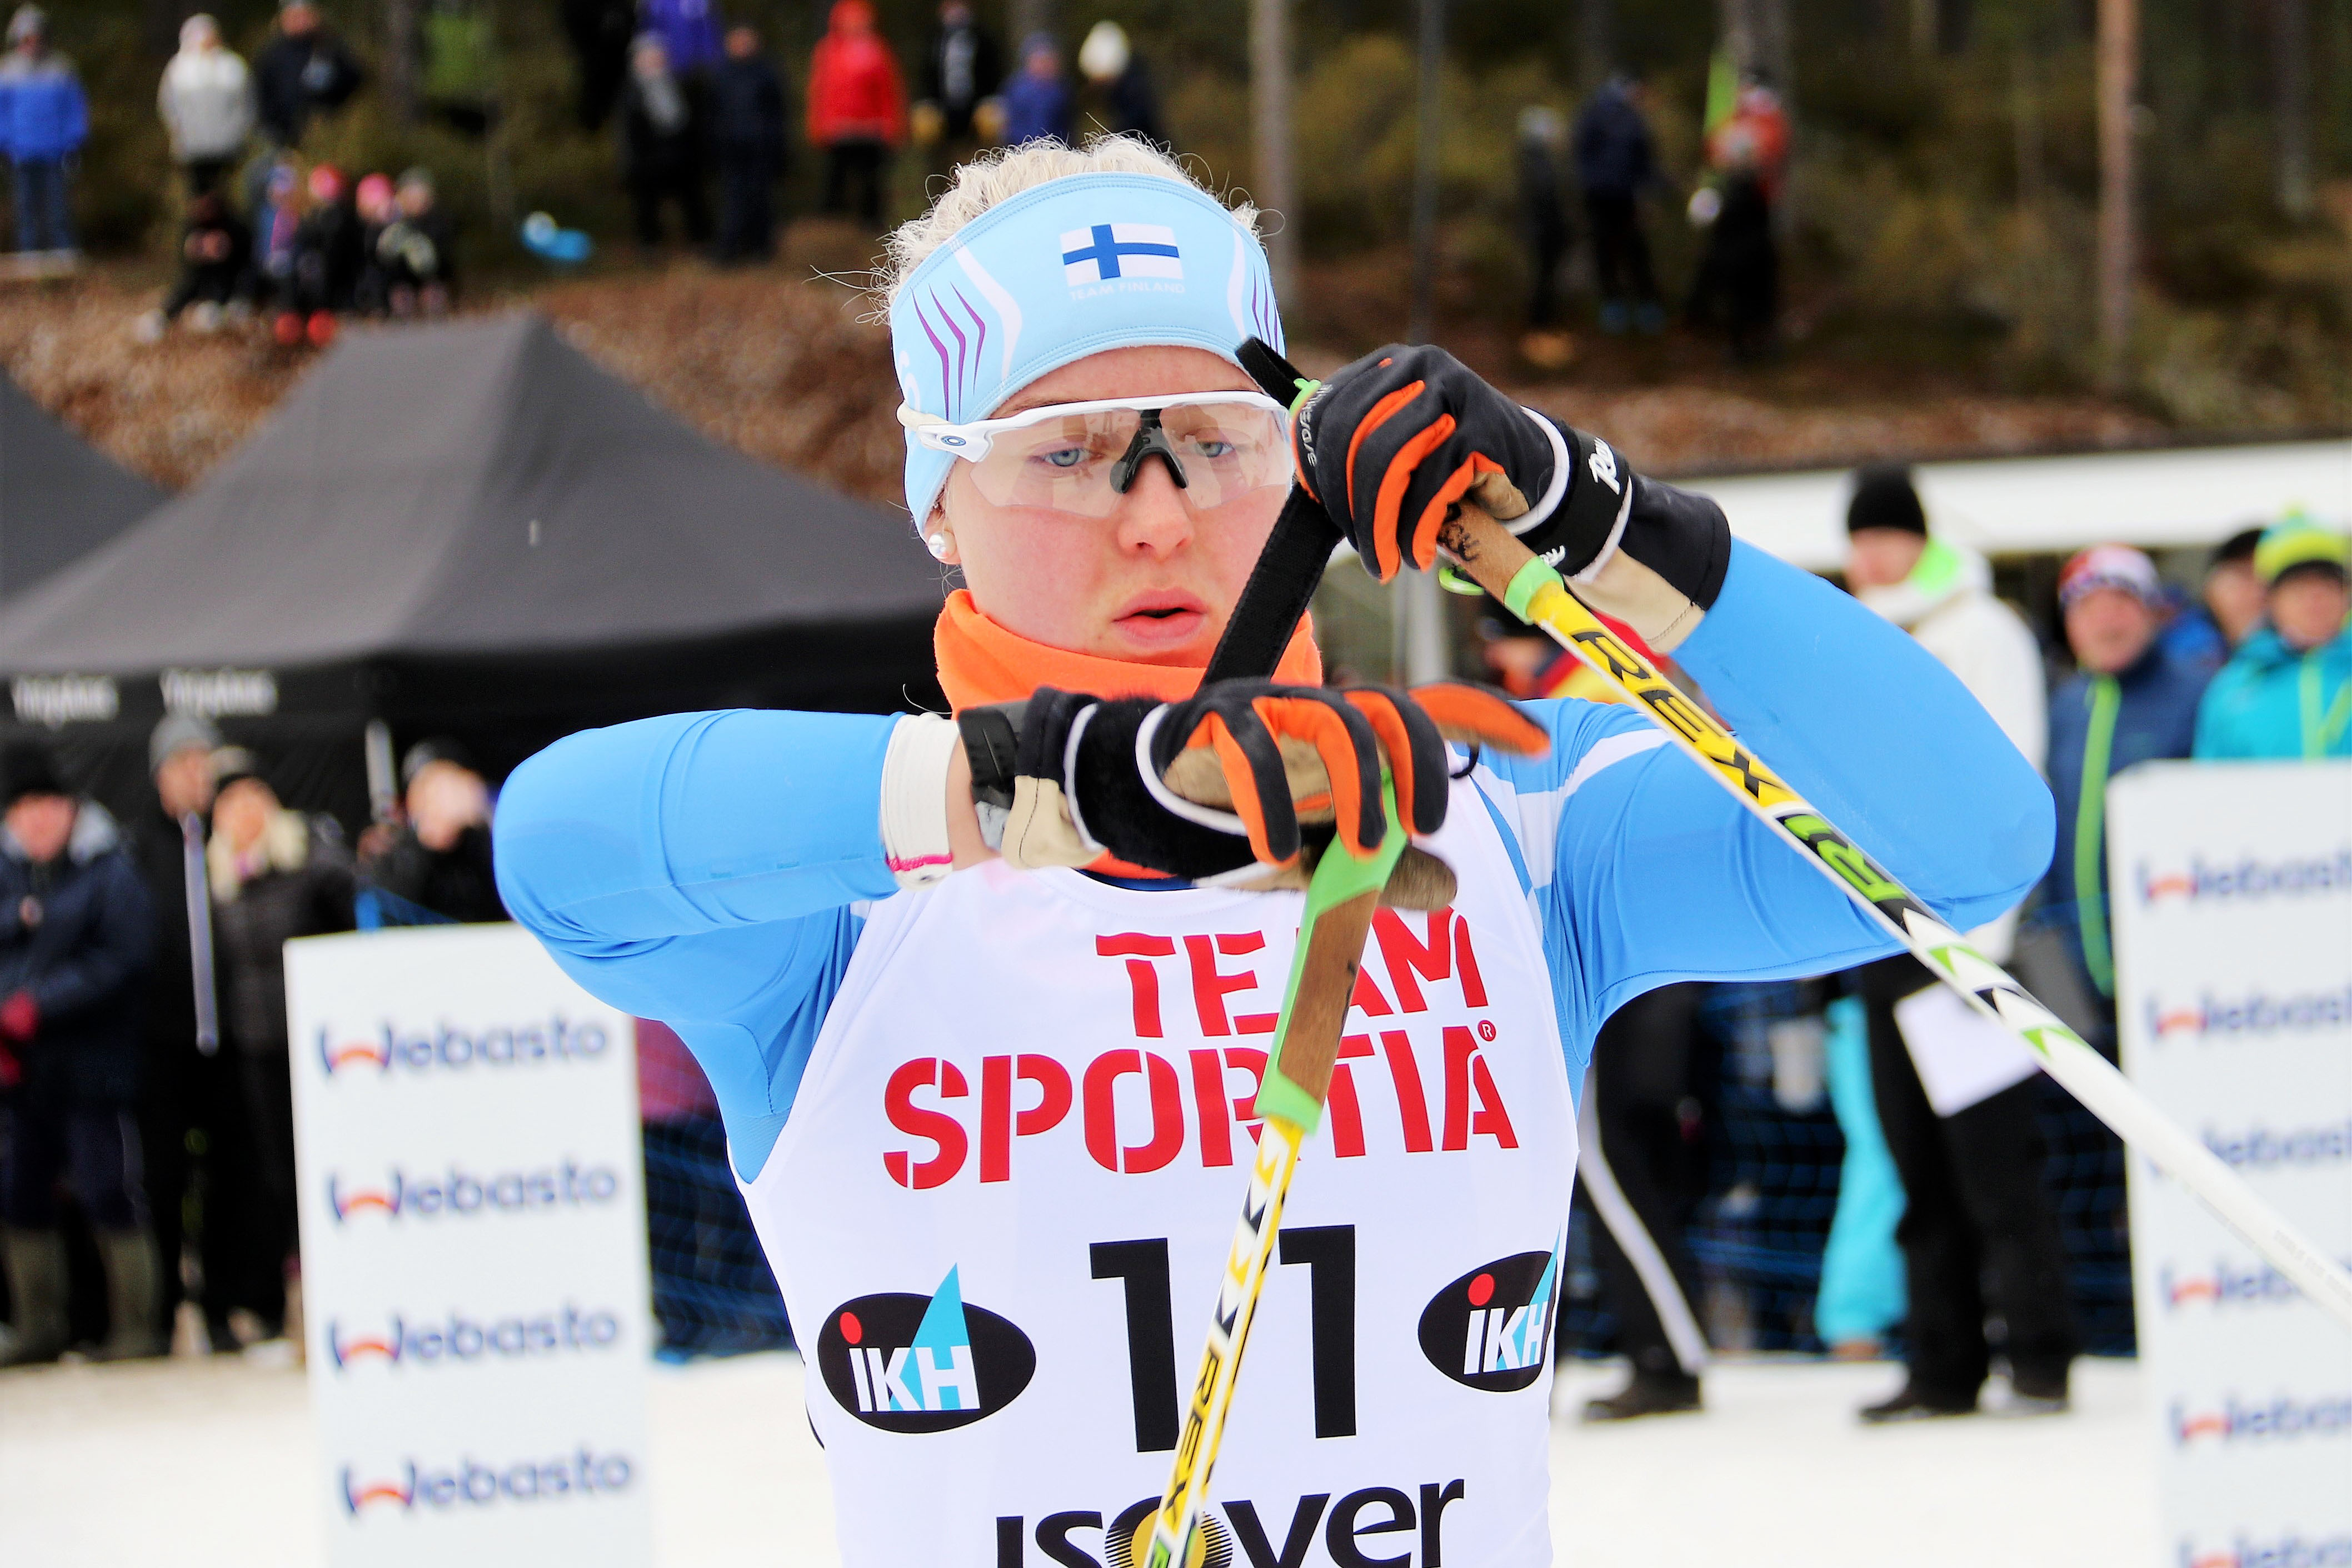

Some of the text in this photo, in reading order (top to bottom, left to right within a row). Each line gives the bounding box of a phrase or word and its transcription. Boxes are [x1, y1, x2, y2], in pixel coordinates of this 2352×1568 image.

[1070, 280, 1185, 302] TEAM FINLAND
[1570, 631, 1800, 800] REX
[316, 1016, 607, 1075] Webasto
[2145, 987, 2352, 1042] Webas
[328, 1161, 617, 1221] Webasto
[328, 1304, 618, 1368] Webasto
[1090, 1224, 1356, 1452] 11
[343, 1447, 632, 1516] Webasto
